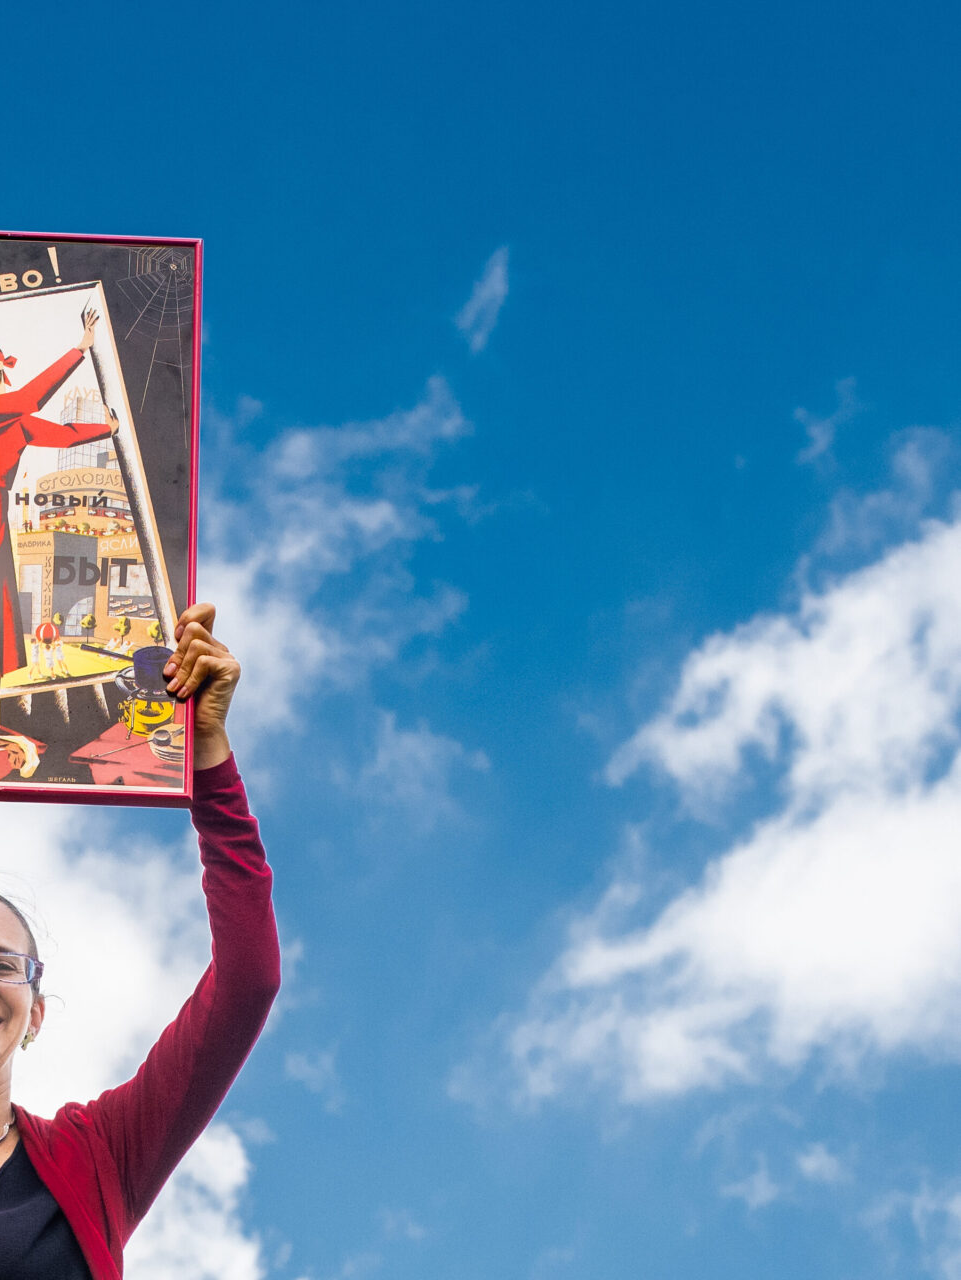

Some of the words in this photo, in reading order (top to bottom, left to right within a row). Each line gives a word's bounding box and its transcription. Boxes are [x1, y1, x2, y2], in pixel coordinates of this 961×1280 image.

[64, 386, 102, 406] КЛУБ
[39, 472, 124, 492] СТОЛОВАЯ
[15, 489, 108, 508] НОВЫЙ
[17, 540, 52, 549] ФАБРИКА
[100, 535, 139, 553] ЯСЛИ
[53, 556, 137, 587] БЫТ
[44, 556, 52, 618] КУХНЯ
